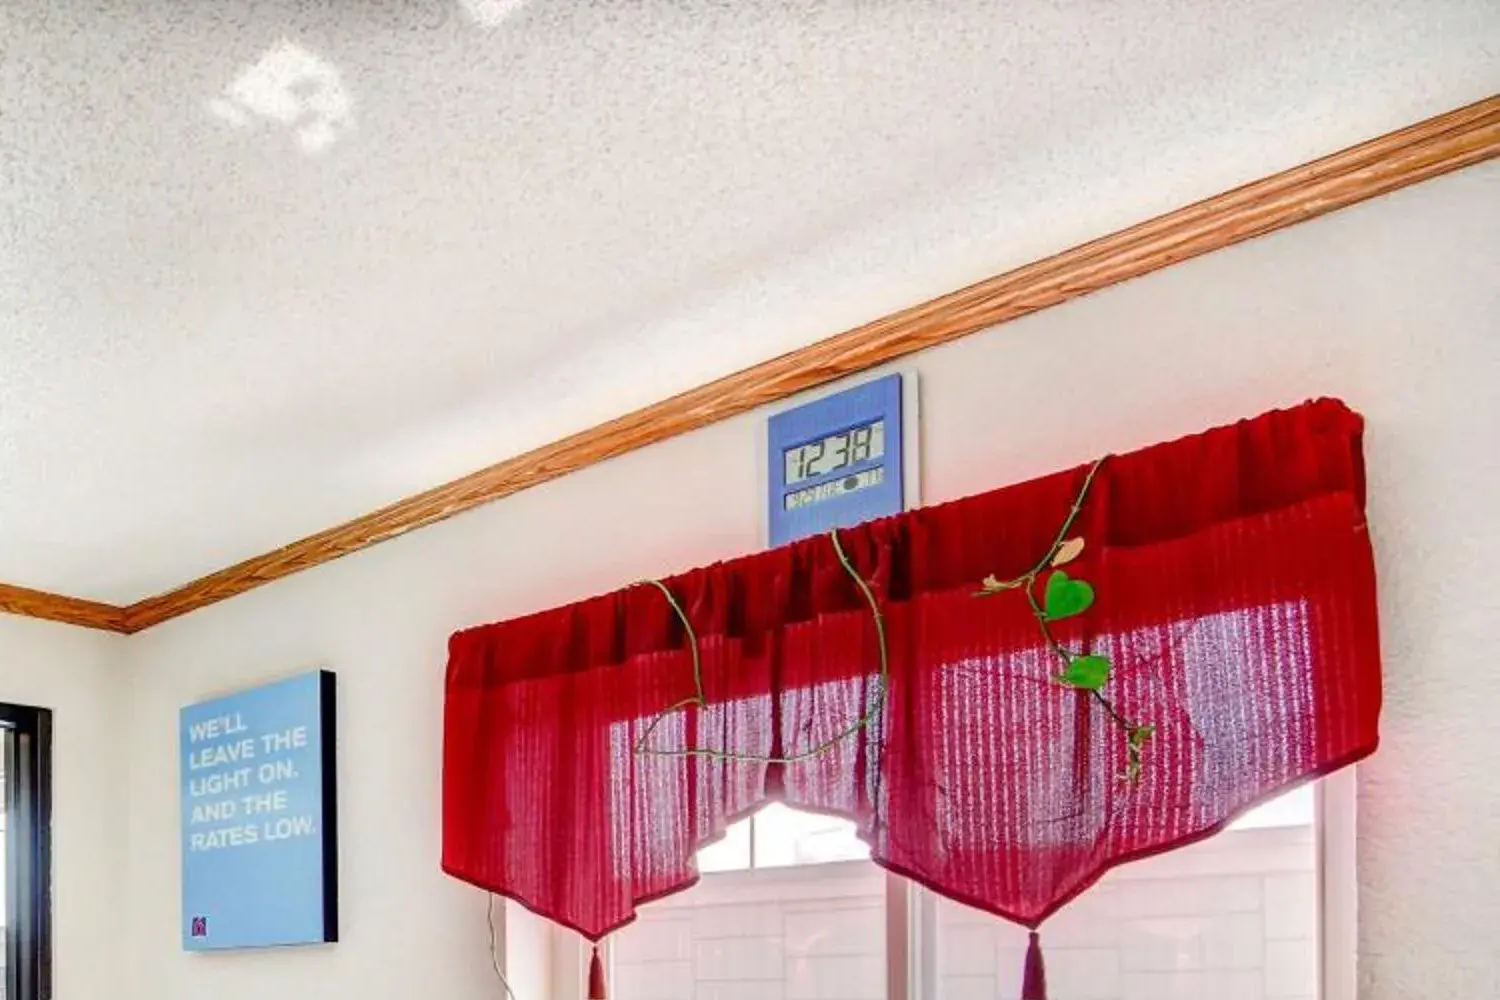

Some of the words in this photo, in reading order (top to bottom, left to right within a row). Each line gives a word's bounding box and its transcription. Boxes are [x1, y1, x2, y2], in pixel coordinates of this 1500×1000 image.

[189, 713, 247, 743] WE'LL
[190, 738, 255, 769] LEAVE
[262, 727, 307, 755] THE
[190, 769, 252, 797] LIGHT
[260, 759, 299, 784] ON.
[191, 800, 236, 823] AND
[243, 790, 288, 815] THE
[191, 825, 259, 851] RATES
